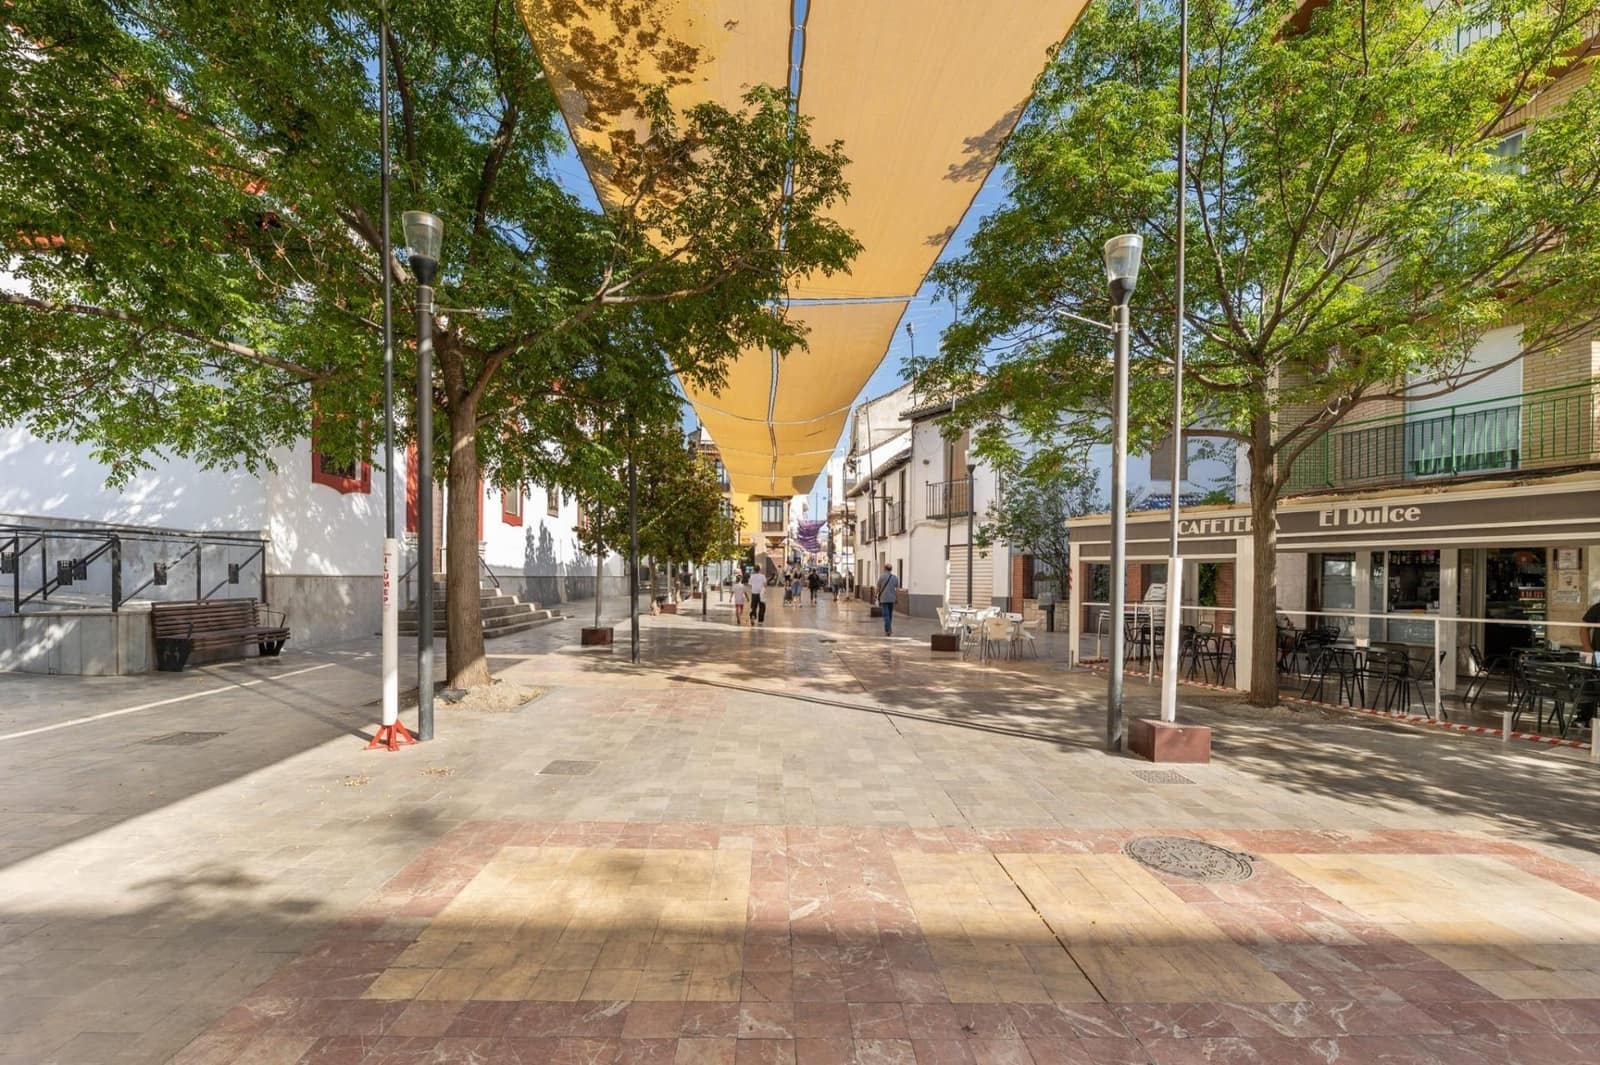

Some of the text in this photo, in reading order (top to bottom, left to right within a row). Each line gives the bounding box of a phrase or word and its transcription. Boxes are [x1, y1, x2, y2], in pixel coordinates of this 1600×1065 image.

[1179, 505, 1422, 535] CAFETERA El Dulce
